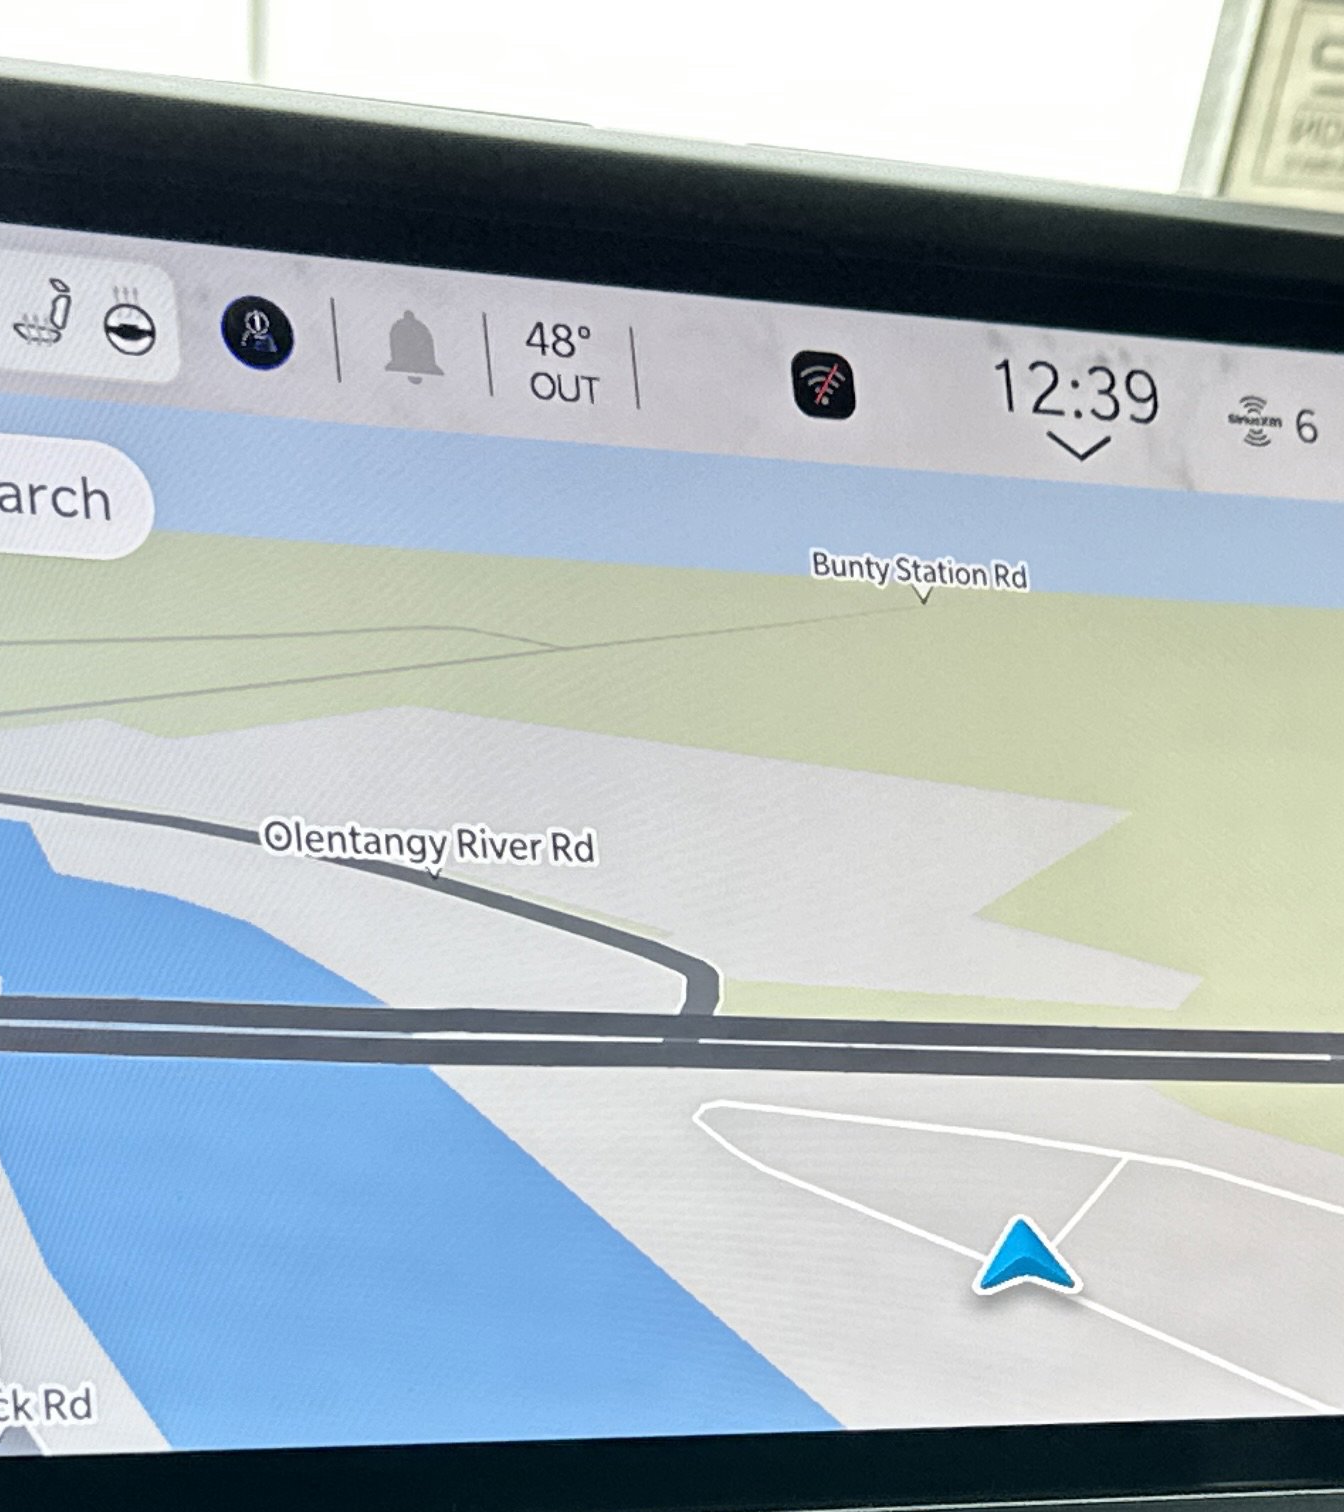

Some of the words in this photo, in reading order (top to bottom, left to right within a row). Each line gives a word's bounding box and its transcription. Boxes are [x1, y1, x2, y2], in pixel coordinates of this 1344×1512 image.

[523, 320, 592, 359] 48°
[529, 371, 601, 406] OUT
[993, 358, 1160, 426] 12:39
[1295, 408, 1319, 444] 6
[812, 551, 890, 586] Bunty
[895, 556, 988, 587] Station
[994, 563, 1028, 590] Rd
[263, 820, 447, 864] Olentangy
[456, 827, 542, 862] River
[550, 832, 595, 863] Rd
[43, 1386, 93, 1421] Rd
